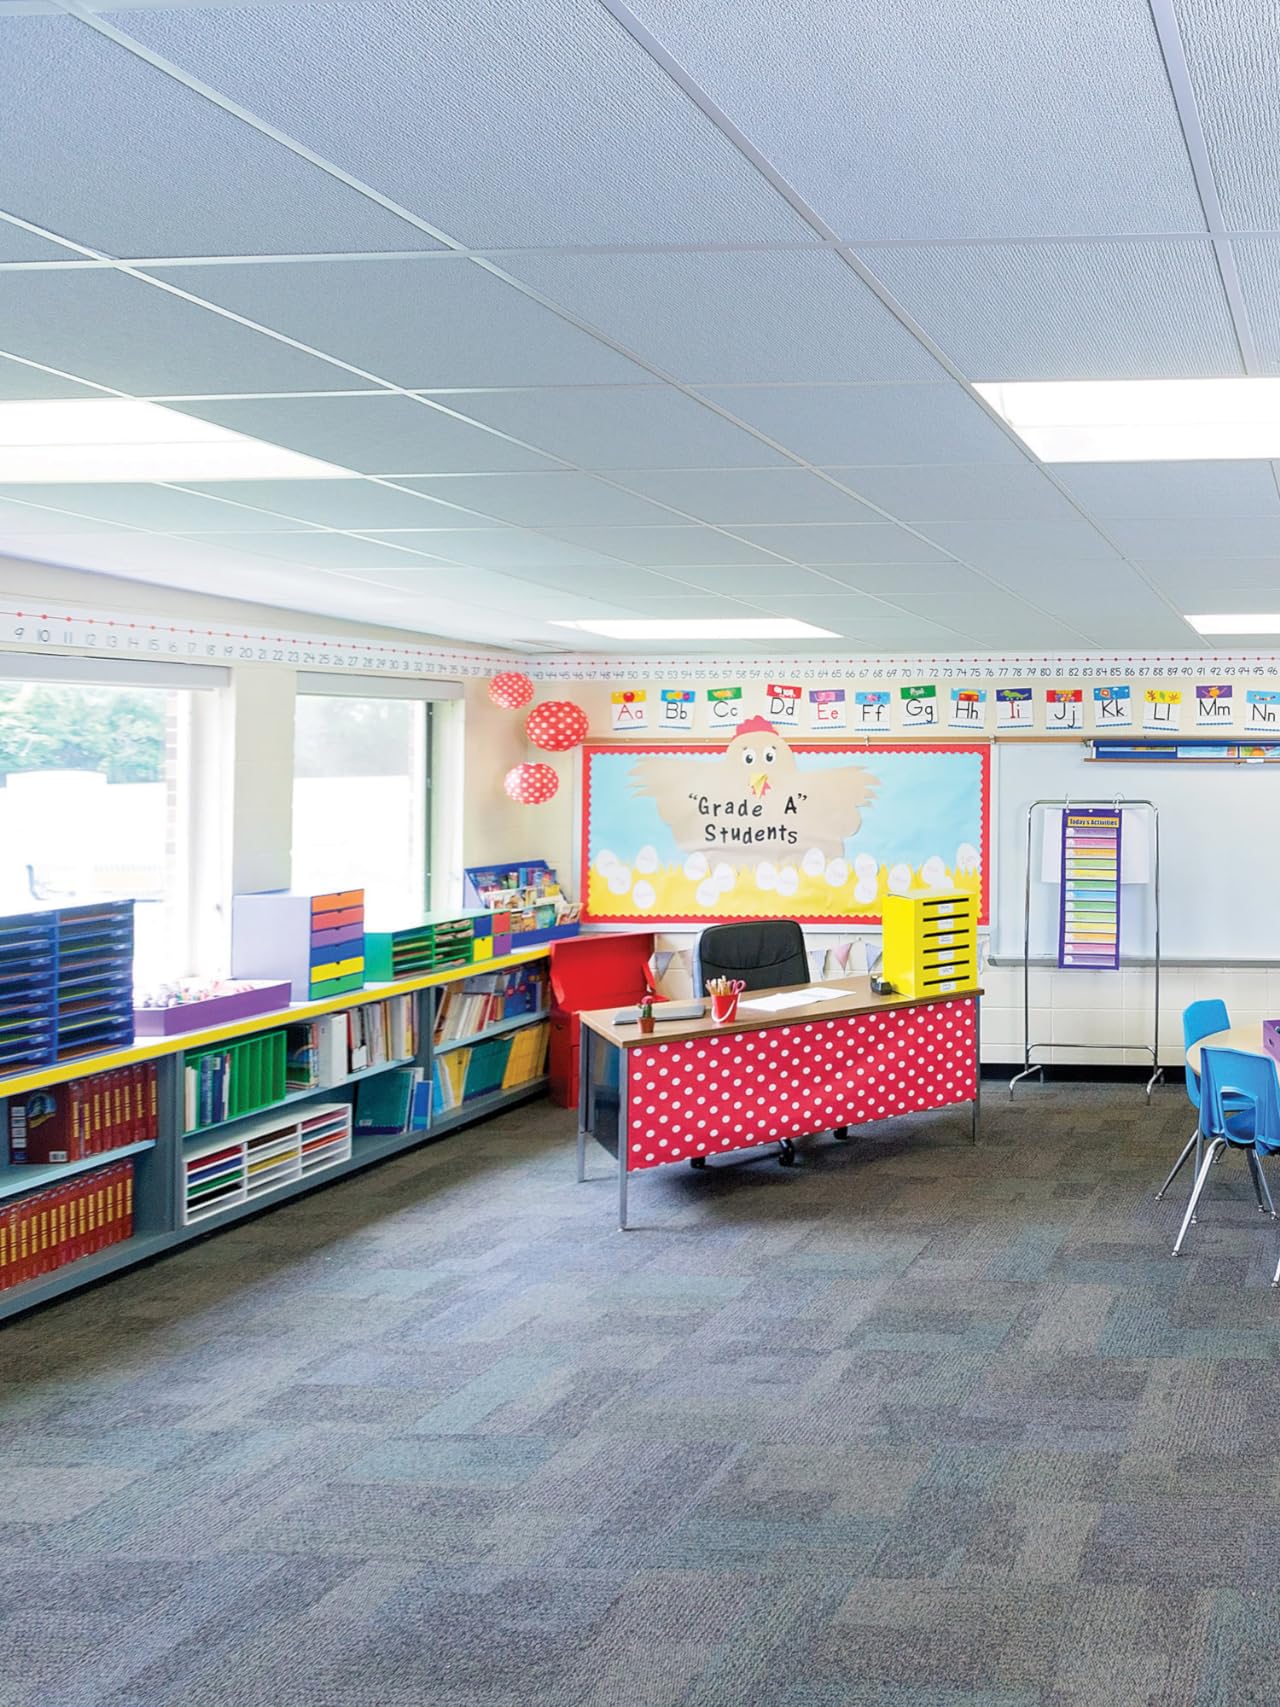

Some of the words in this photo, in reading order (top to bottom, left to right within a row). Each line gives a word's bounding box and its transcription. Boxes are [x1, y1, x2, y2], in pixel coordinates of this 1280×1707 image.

[37, 629, 50, 642] 10
[764, 669, 774, 678] 60
[778, 669, 785, 678] 61
[791, 669, 801, 678] 62
[804, 669, 814, 678] 63
[818, 669, 828, 678] 64
[832, 669, 841, 678] 65
[846, 669, 855, 678] 66
[859, 669, 869, 678] 67
[873, 669, 883, 678] 68
[887, 669, 897, 678] 69
[902, 668, 911, 677] 70
[916, 668, 923, 677] 71
[929, 668, 938, 677] 72
[943, 668, 952, 677] 73
[956, 668, 966, 677] 74
[970, 668, 981, 677] 75
[985, 668, 994, 677] 76
[999, 668, 1008, 677] 77
[1013, 668, 1022, 677] 78
[1027, 668, 1036, 677] 79
[1040, 668, 1051, 677] 80
[1056, 668, 1063, 677] 81
[1069, 667, 1079, 676] 82
[1083, 667, 1093, 676] 83
[1096, 667, 1107, 676] 84
[1110, 667, 1121, 676] 85
[1125, 667, 1135, 676] 86
[1139, 667, 1150, 676] 87
[1153, 667, 1163, 676] 88
[1168, 667, 1178, 676] 89
[1181, 667, 1193, 676] 90
[1197, 667, 1205, 676] 91
[1210, 667, 1221, 676] 92
[1224, 667, 1235, 676] 93
[1238, 666, 1250, 675] 94
[1253, 666, 1264, 675] 95
[1267, 666, 1278, 675] 96
[617, 704, 643, 721] Aa
[665, 702, 687, 720] Bb
[713, 701, 738, 718] Cc
[770, 698, 794, 716] Dd
[817, 702, 838, 720] Ee
[862, 704, 884, 721] Ff
[906, 699, 933, 724] Gg
[956, 701, 978, 720] Hh
[1054, 702, 1076, 728] Jj
[1102, 700, 1124, 717] Kk
[1200, 698, 1230, 716] Mm
[1253, 704, 1276, 722] Nn
[705, 824, 798, 844] Students
